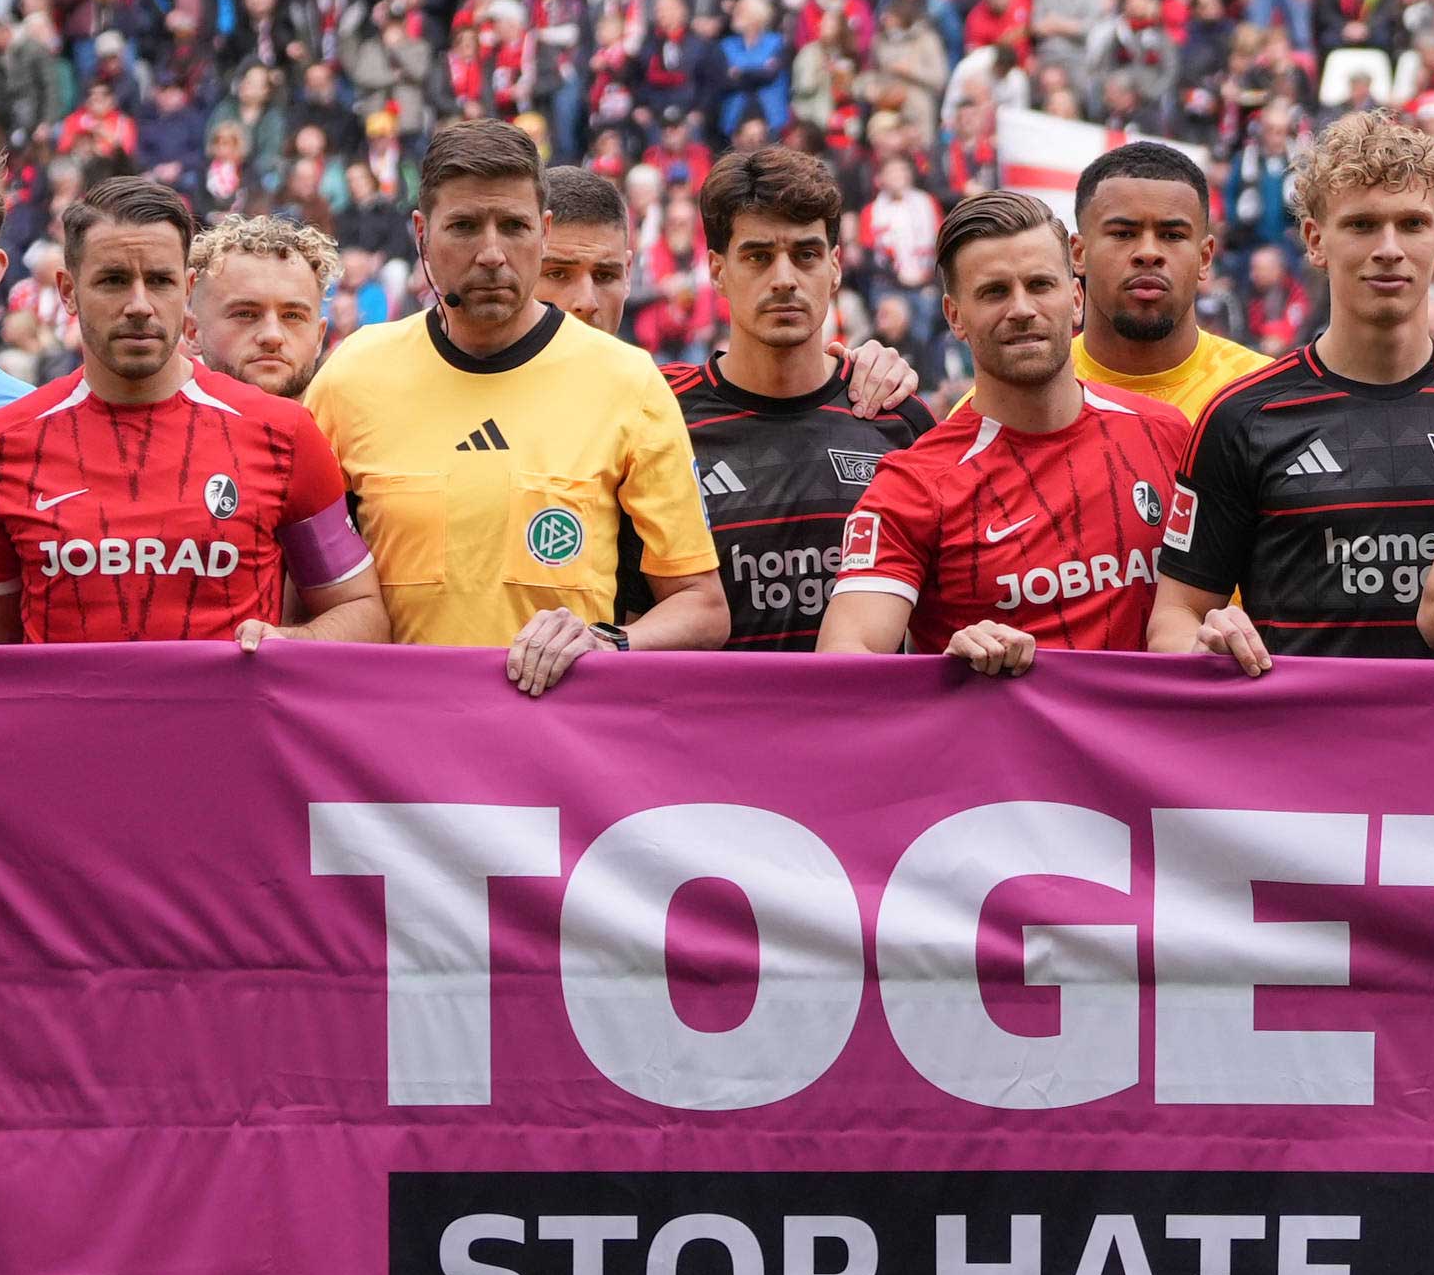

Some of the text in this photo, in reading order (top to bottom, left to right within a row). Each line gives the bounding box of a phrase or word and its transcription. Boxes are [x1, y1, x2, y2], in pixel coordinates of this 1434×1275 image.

[40, 537, 239, 579] JOBRAD
[731, 543, 841, 582] home
[750, 578, 791, 610] to
[1342, 564, 1382, 595] to
